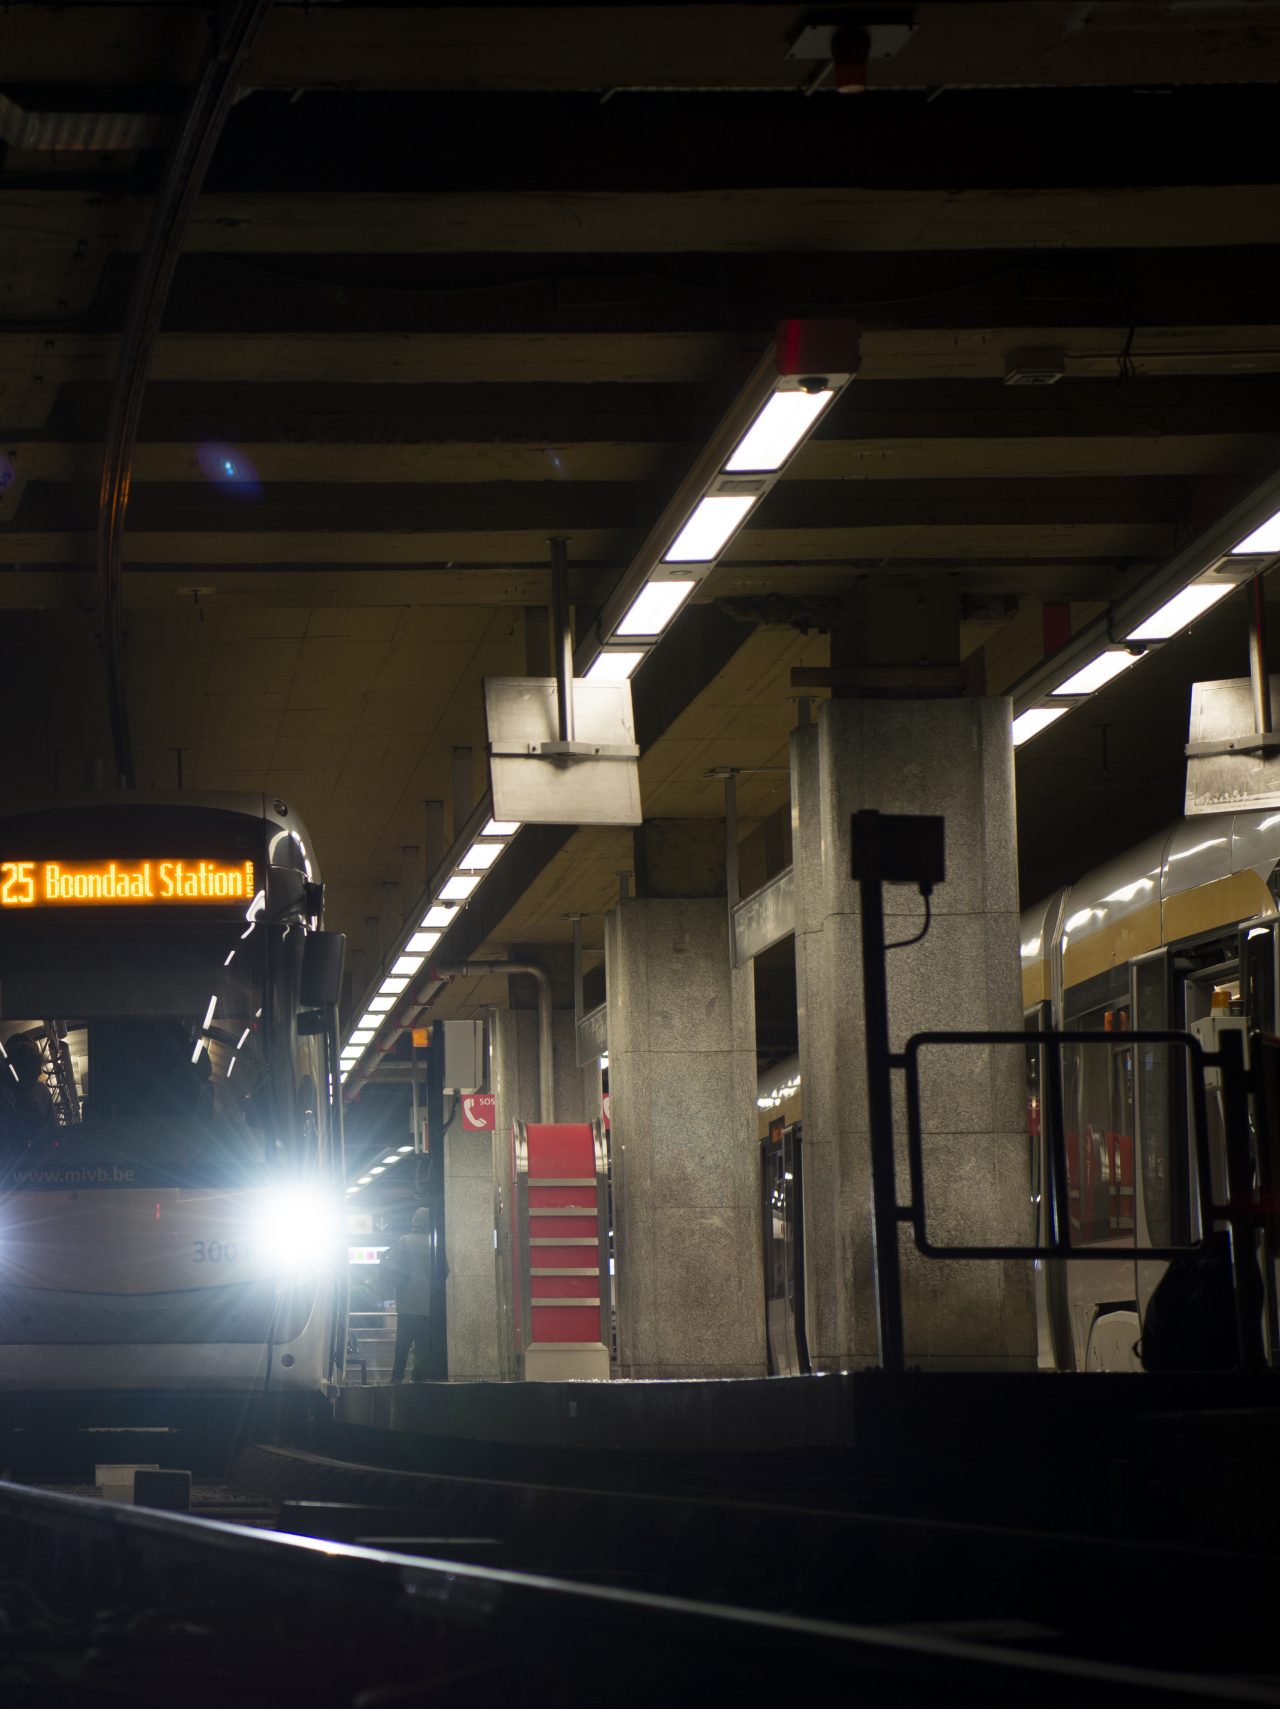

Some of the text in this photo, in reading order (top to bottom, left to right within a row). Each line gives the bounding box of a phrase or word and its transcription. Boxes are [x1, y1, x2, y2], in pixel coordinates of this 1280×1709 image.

[1, 862, 243, 904] 25 Boondaal Station
[479, 1097, 496, 1105] SOS
[14, 1165, 136, 1183] www.mivb.be
